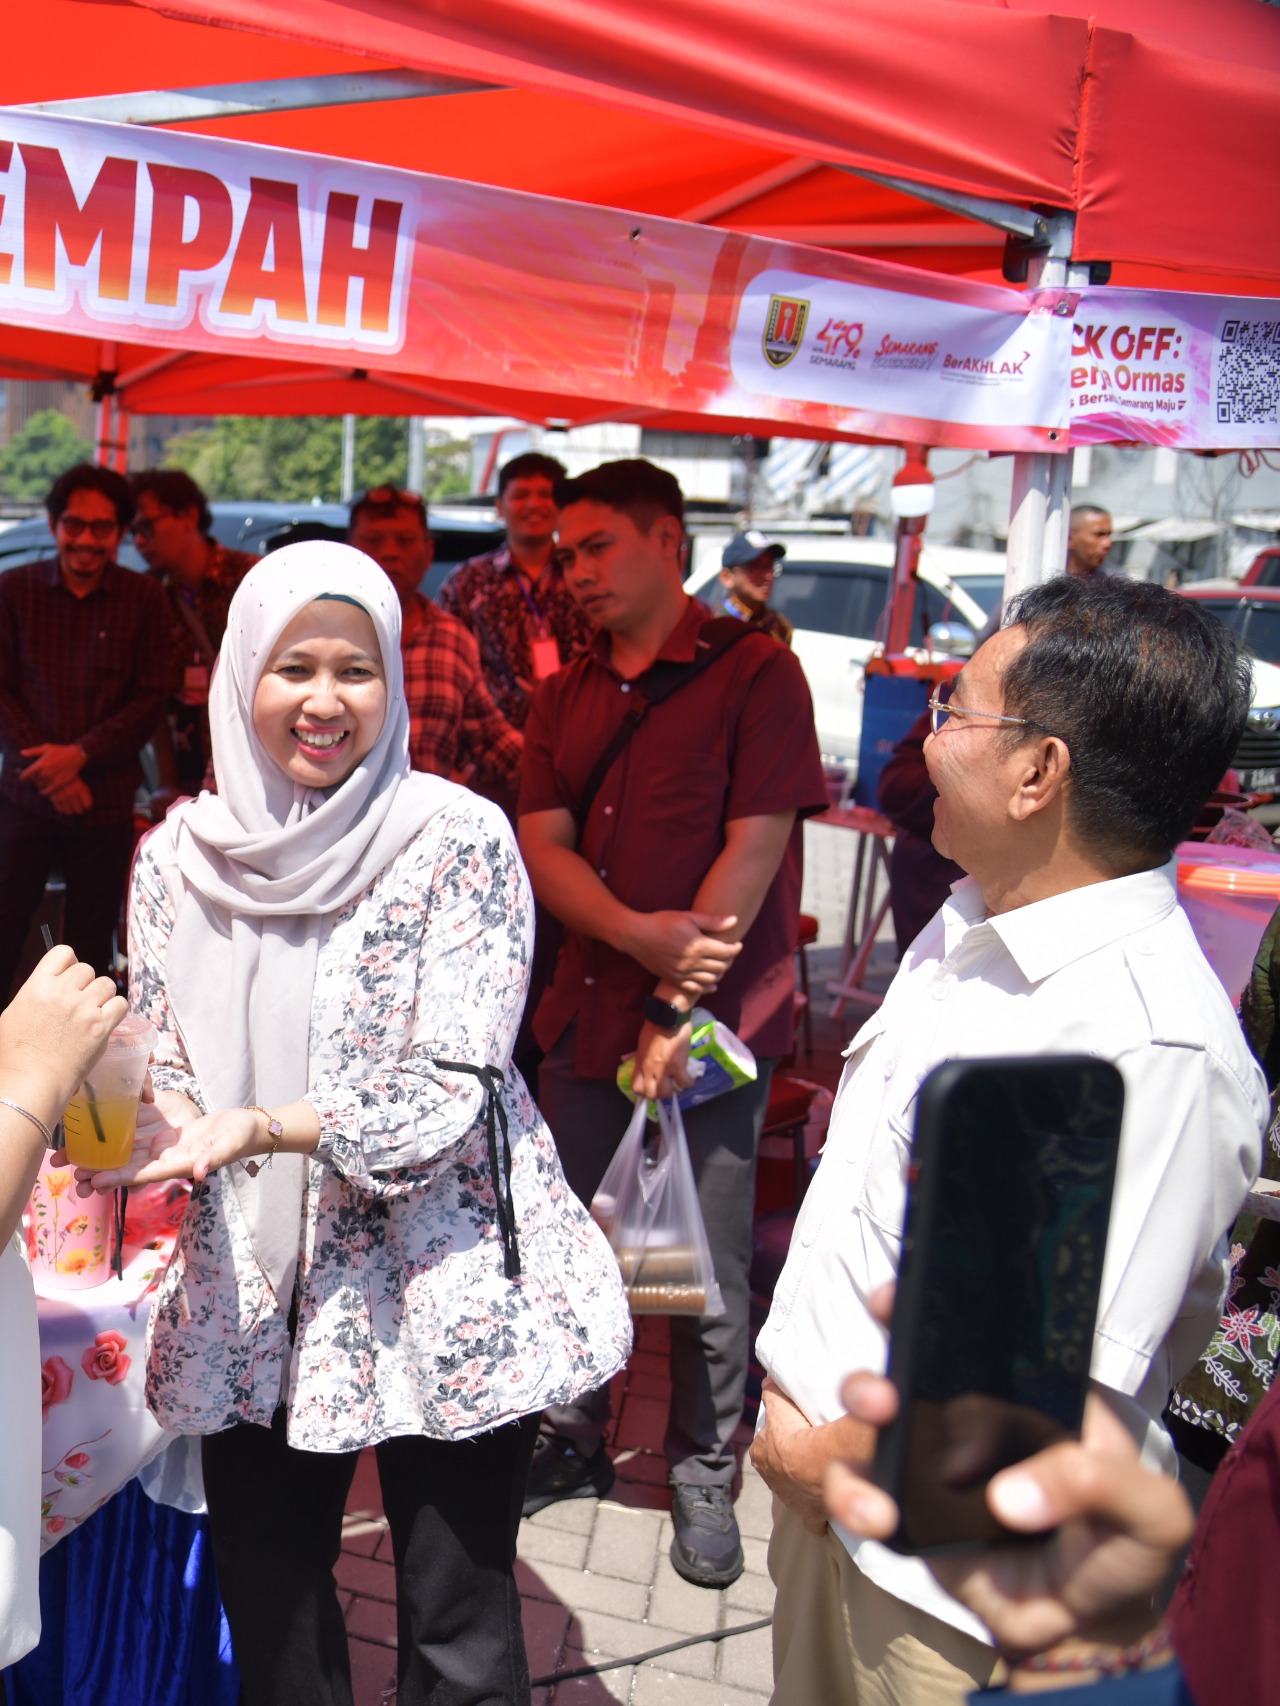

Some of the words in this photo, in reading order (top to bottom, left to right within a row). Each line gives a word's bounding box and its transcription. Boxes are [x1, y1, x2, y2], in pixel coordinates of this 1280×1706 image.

[1110, 325, 1182, 361] OFF:
[942, 353, 1024, 375] BerAKHLAK
[1114, 364, 1186, 393] Ormas
[1156, 400, 1176, 412] Maju
